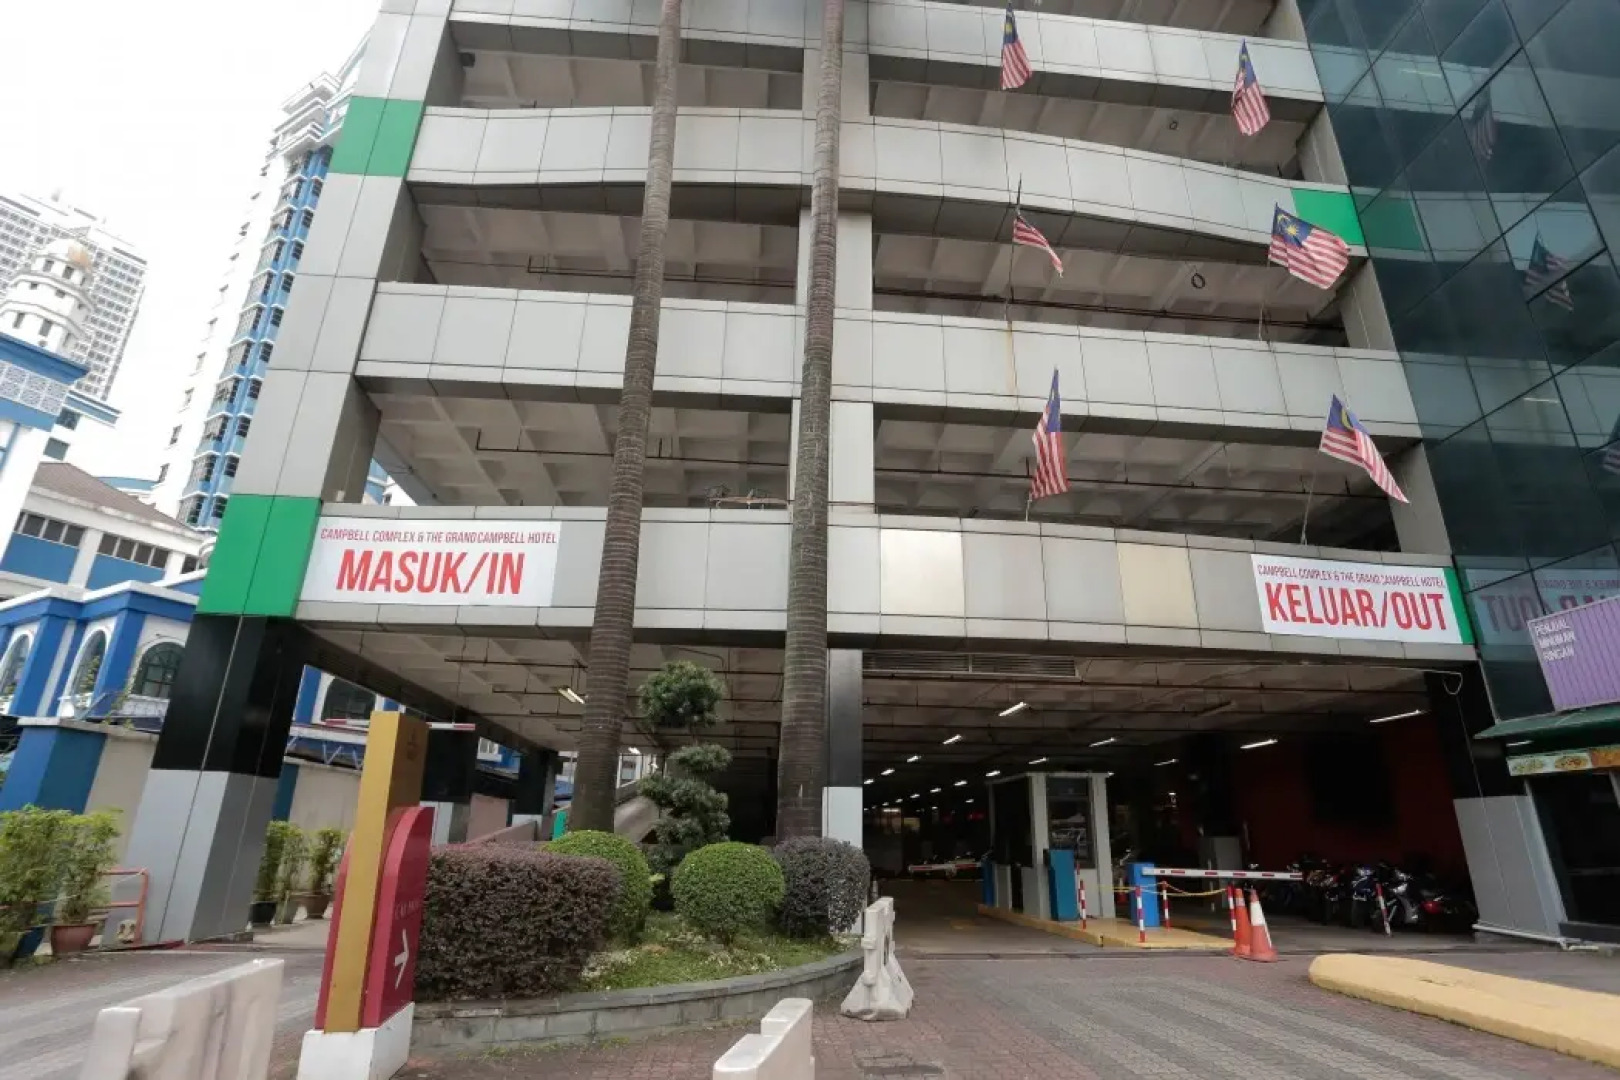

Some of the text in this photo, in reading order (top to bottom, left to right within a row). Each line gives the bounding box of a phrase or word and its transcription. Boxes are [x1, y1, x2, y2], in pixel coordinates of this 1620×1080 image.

[320, 528, 558, 543] CAMPBELL COMPLEX & THE GRAND CAMPBELL HOTEL
[336, 549, 525, 594] MASUK/IN
[1258, 565, 1297, 578] CAMPBELL
[1299, 568, 1333, 580] COMPLEX
[1341, 572, 1354, 583] THE
[1355, 573, 1381, 584] GRAND
[1382, 574, 1420, 587] CAMPBELL
[1420, 577, 1445, 588] HOTEL
[1265, 582, 1446, 630] KELUAR/OUT
